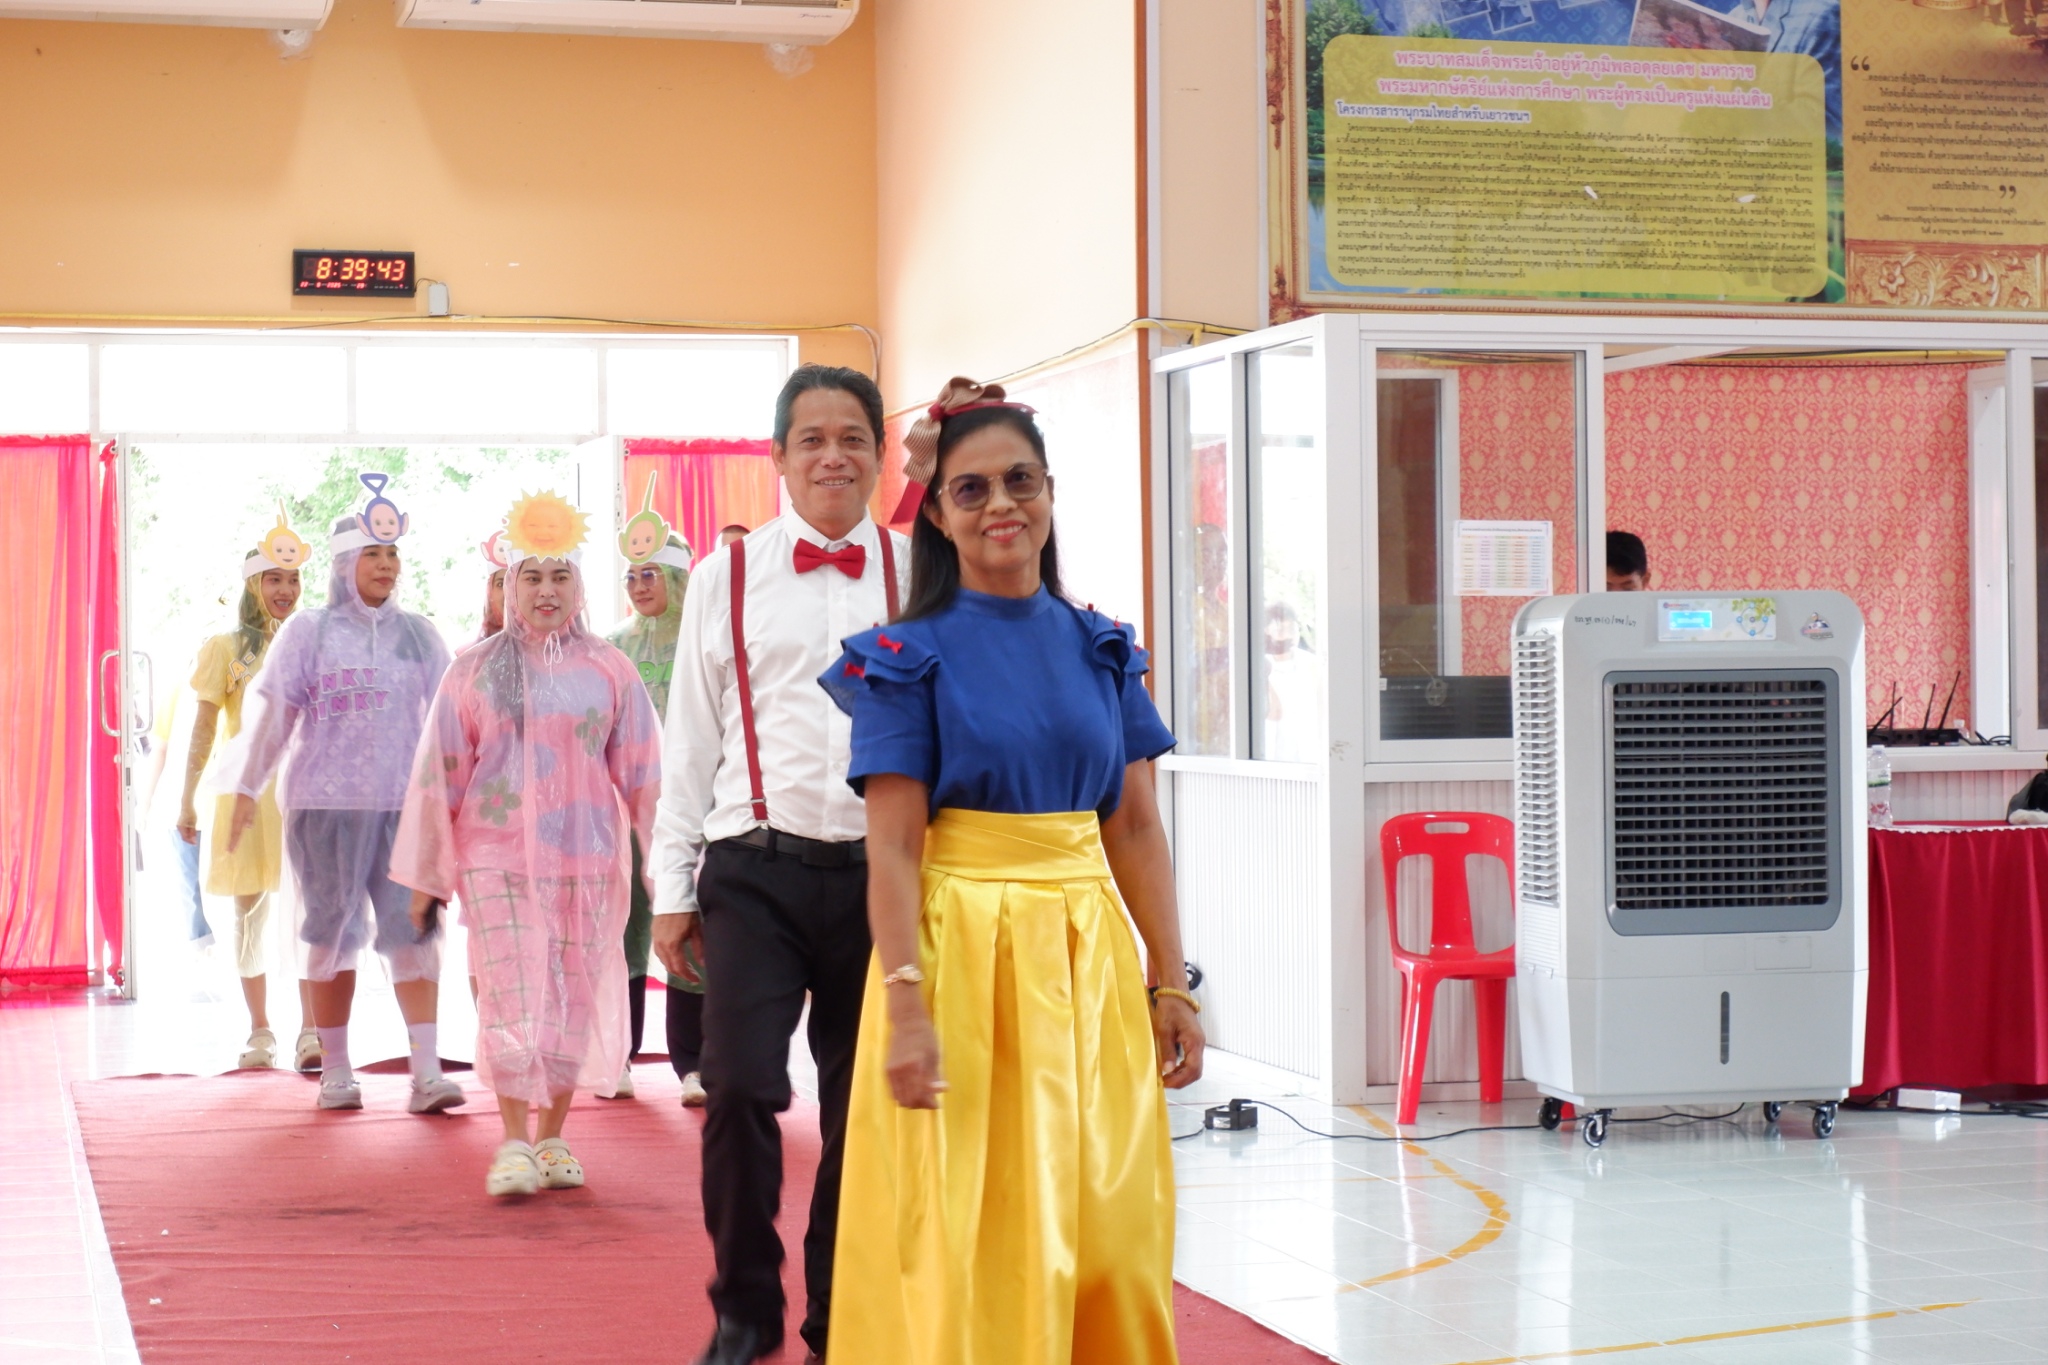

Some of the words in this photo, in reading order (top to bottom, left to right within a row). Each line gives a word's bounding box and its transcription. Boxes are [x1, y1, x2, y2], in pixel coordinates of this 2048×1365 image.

[1396, 49, 1695, 79] พระบาทสมเด็จพระเจ้าอยู่หัวภูมิพลอดุลยเดช
[1701, 65, 1755, 79] มหาราช
[1379, 77, 1580, 99] พระมหากษัตริย์แห่งการศึกษา
[1587, 82, 1771, 110] พระผู้ทรงเป็นครูแห่งแผ่นดิน
[1338, 102, 1530, 121] โครงการสารานุกรมไทยสำหรับเยาวชนฯ
[316, 258, 406, 281] 8:39:43
